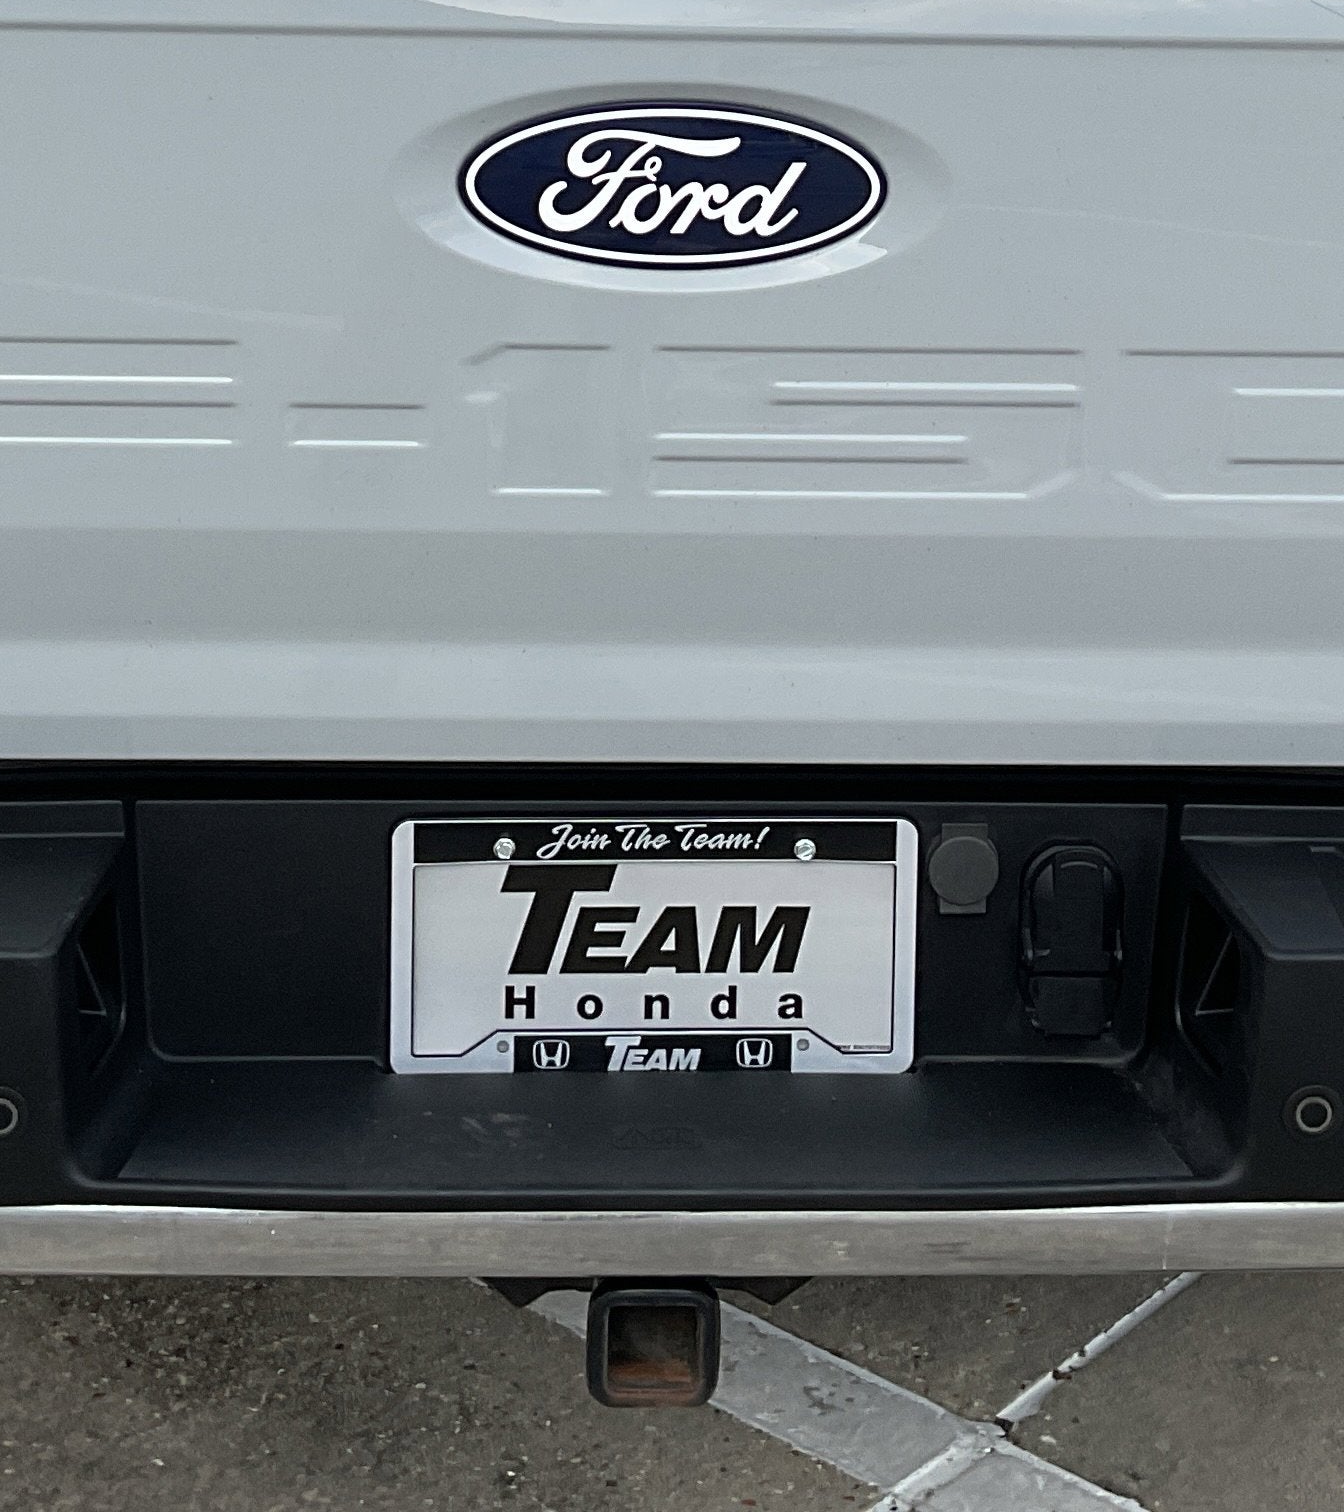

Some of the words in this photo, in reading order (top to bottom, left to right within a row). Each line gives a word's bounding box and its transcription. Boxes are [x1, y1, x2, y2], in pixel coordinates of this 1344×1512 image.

[537, 129, 807, 238] Ford
[536, 824, 611, 859] Join
[613, 823, 672, 852] The
[674, 823, 771, 852] Team!
[499, 863, 811, 976] TEAM
[503, 985, 804, 1021] Honda
[604, 1035, 702, 1072] TEAM
